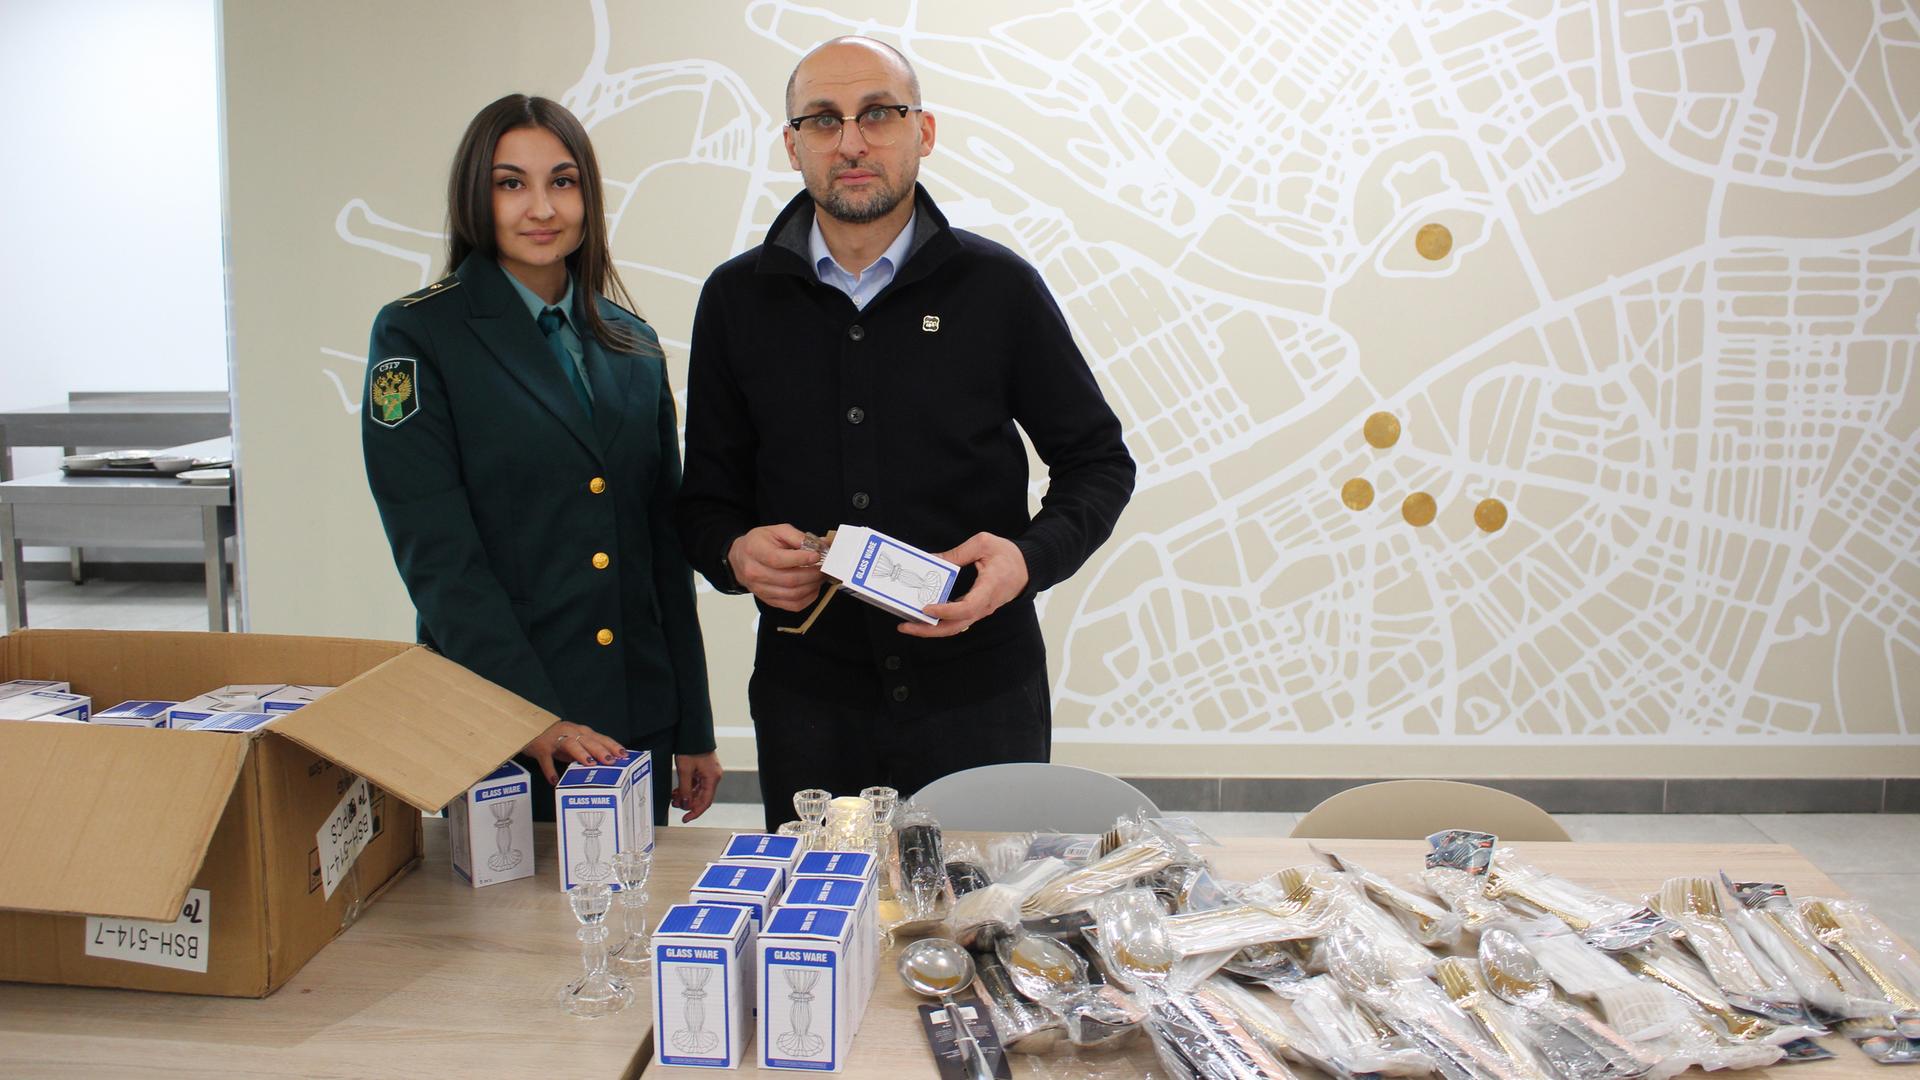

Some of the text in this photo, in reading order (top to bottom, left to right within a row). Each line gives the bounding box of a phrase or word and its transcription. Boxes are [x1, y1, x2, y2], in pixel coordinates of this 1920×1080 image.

[855, 540, 877, 579] GLASS WARE
[481, 784, 521, 799] GLASS WARE
[568, 797, 611, 805] GLASS WARE
[94, 921, 199, 959] BSH-514-7
[666, 947, 719, 960] GLASS WARE
[774, 950, 828, 963] GLASS WARE
